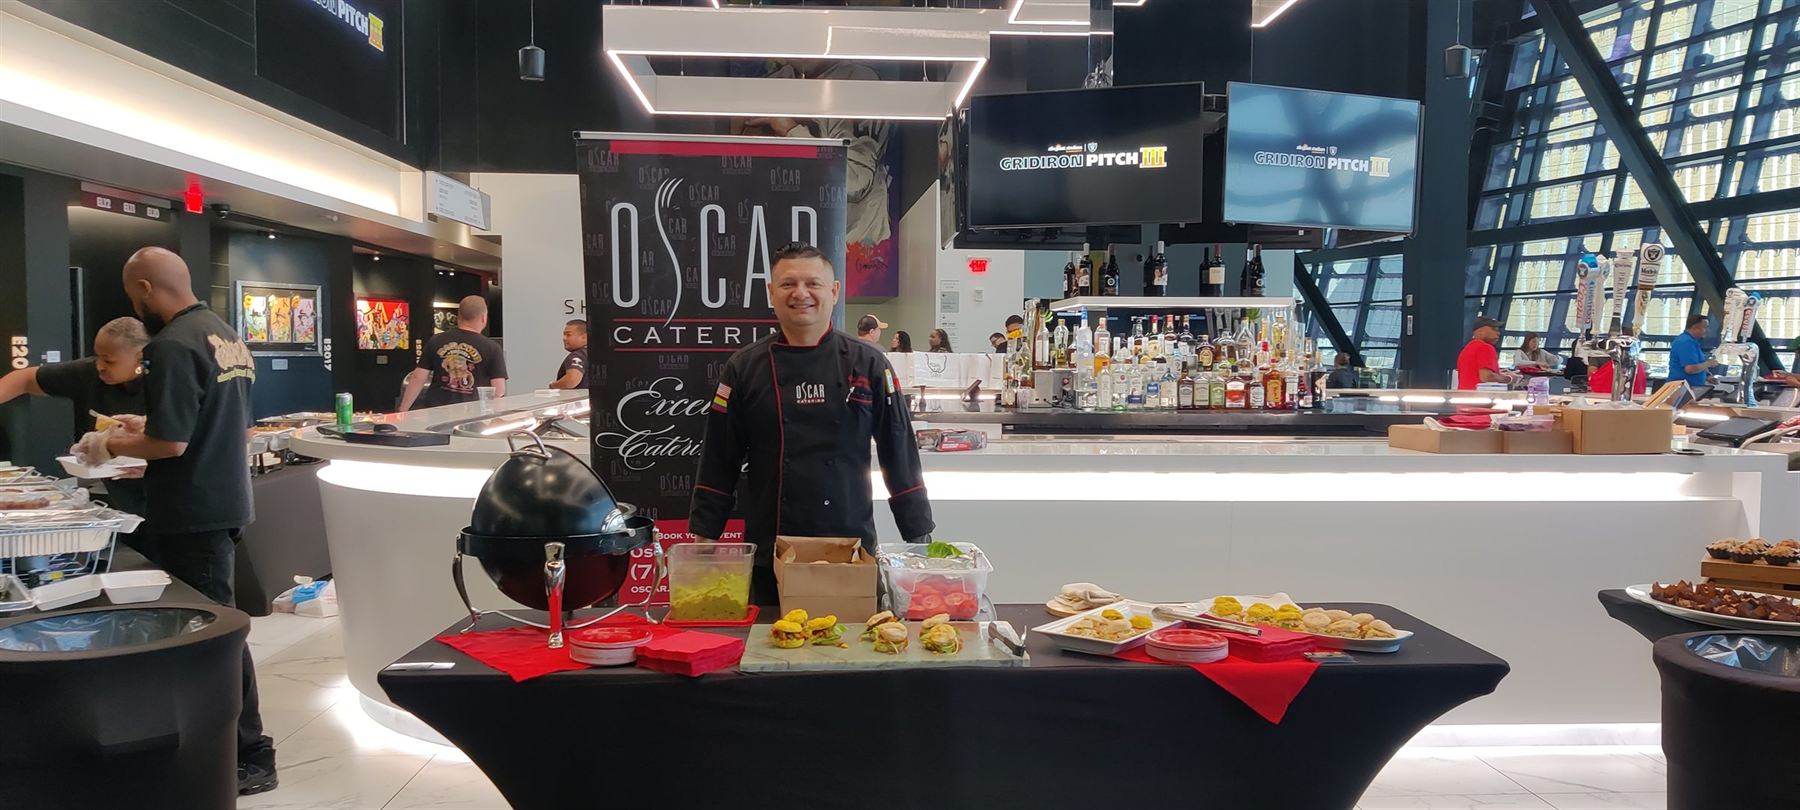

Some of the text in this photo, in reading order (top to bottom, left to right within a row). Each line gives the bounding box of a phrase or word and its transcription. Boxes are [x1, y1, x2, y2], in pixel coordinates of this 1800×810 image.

[337, 0, 369, 36] PITCH
[1000, 146, 1168, 171] GRIDIRON PITCH III
[1254, 151, 1391, 177] GRIDIRON PITCH III
[11, 336, 29, 369] E20
[323, 338, 332, 371] E2017
[796, 382, 825, 399] OSCAR
